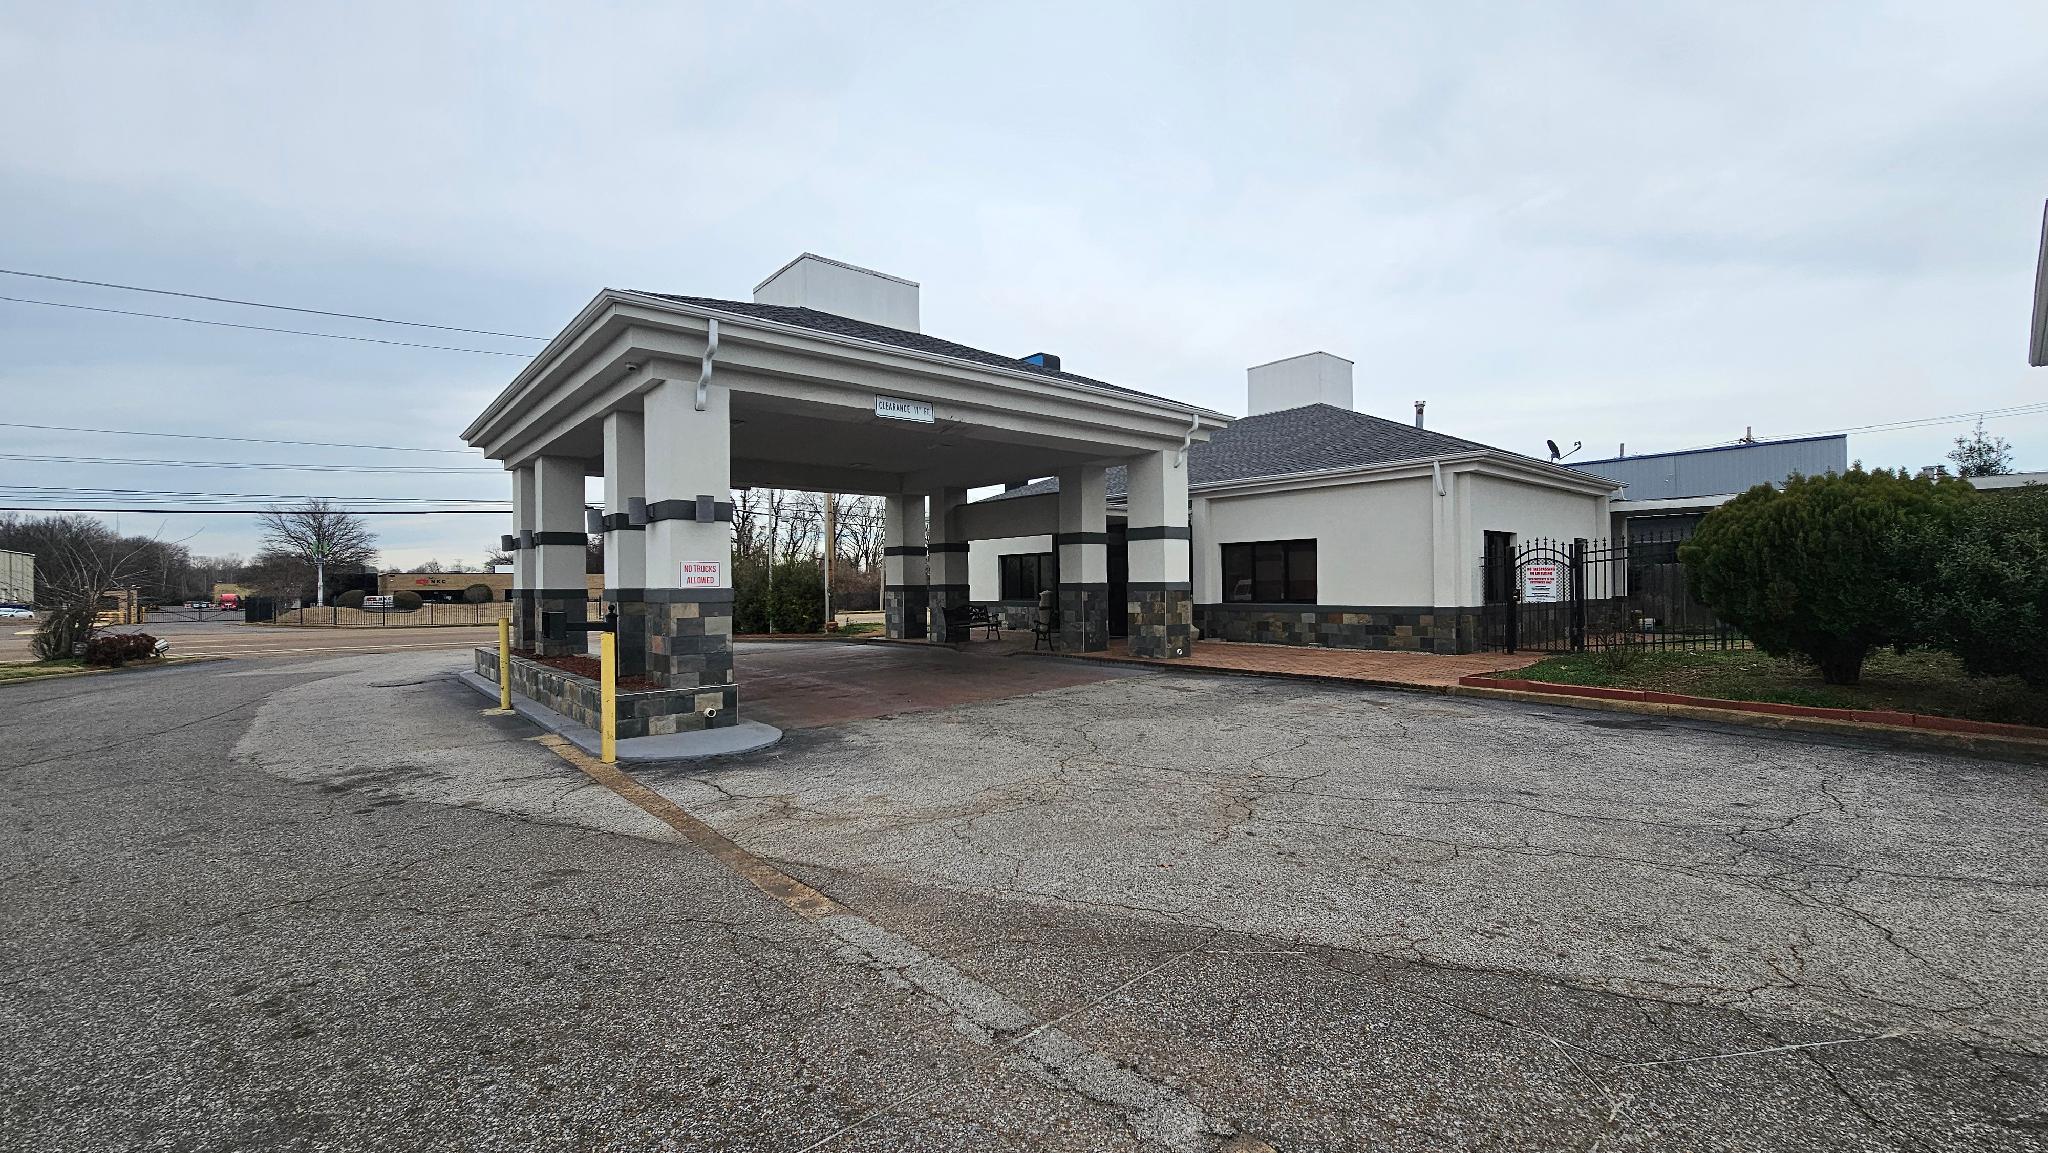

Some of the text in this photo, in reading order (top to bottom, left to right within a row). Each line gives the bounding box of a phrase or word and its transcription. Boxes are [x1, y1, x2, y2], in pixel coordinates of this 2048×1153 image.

[879, 401, 911, 414] CLEARANCE
[684, 564, 717, 573] NO TRUCKS
[686, 576, 715, 585] ALLOWED
